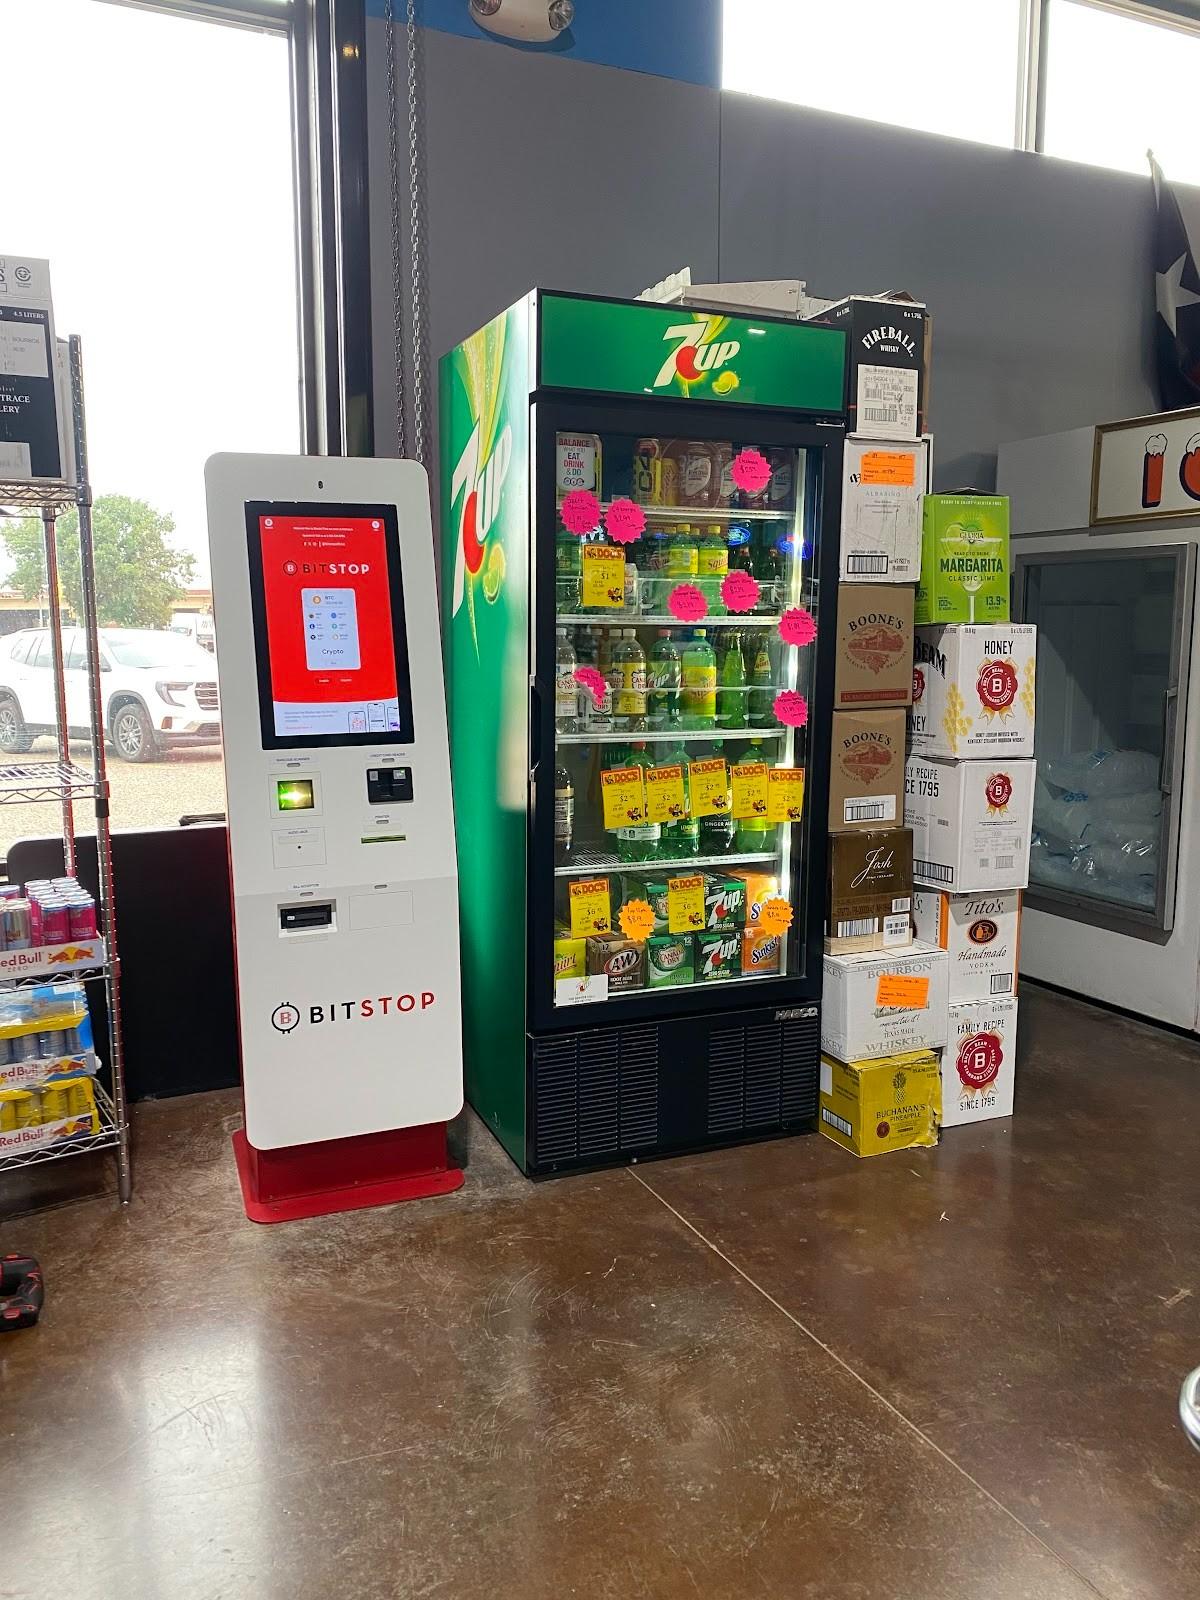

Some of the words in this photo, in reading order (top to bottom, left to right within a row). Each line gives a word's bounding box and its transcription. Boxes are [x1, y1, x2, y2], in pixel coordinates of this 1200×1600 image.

[861, 326, 916, 354] FIREBALL
[653, 321, 740, 387] 7UP
[558, 438, 591, 448] BALANCE
[564, 459, 585, 468] DRINK
[568, 452, 580, 460] EAT
[572, 468, 582, 476] DO
[303, 564, 370, 574] BITSTOP
[940, 558, 1004, 573] MARGARITA
[848, 613, 904, 632] BOONE'S
[984, 640, 1014, 654] HONEY
[992, 678, 1002, 692] B
[906, 716, 926, 732] ONEY
[843, 732, 892, 748] BOONE'S
[916, 767, 938, 780] RECIPE
[918, 780, 939, 798] 1795
[850, 846, 894, 888] Josh
[964, 898, 1003, 916] Tito's
[684, 936, 692, 944] 12
[1, 954, 16, 967] ed
[18, 952, 41, 965] Bull
[958, 944, 1007, 961] Handmade
[823, 964, 844, 979] SKEY
[868, 962, 933, 979] BOURBON
[310, 992, 434, 1024] BITSTOP
[280, 1012, 291, 1024] B
[957, 1022, 980, 1034] FAMILY
[984, 1019, 1005, 1031] RECIPE
[822, 1034, 842, 1052] SKEY
[865, 1035, 927, 1052] WHISKEY
[974, 1052, 986, 1068] B
[1, 1068, 15, 1079] ed
[960, 1100, 979, 1111] SINCE
[982, 1096, 996, 1108] 1795
[876, 1104, 926, 1119] BUCHANAN'S
[890, 1112, 921, 1122] PINEAPPLE
[0, 1134, 21, 1147] Red
[22, 1128, 44, 1141] Bull
